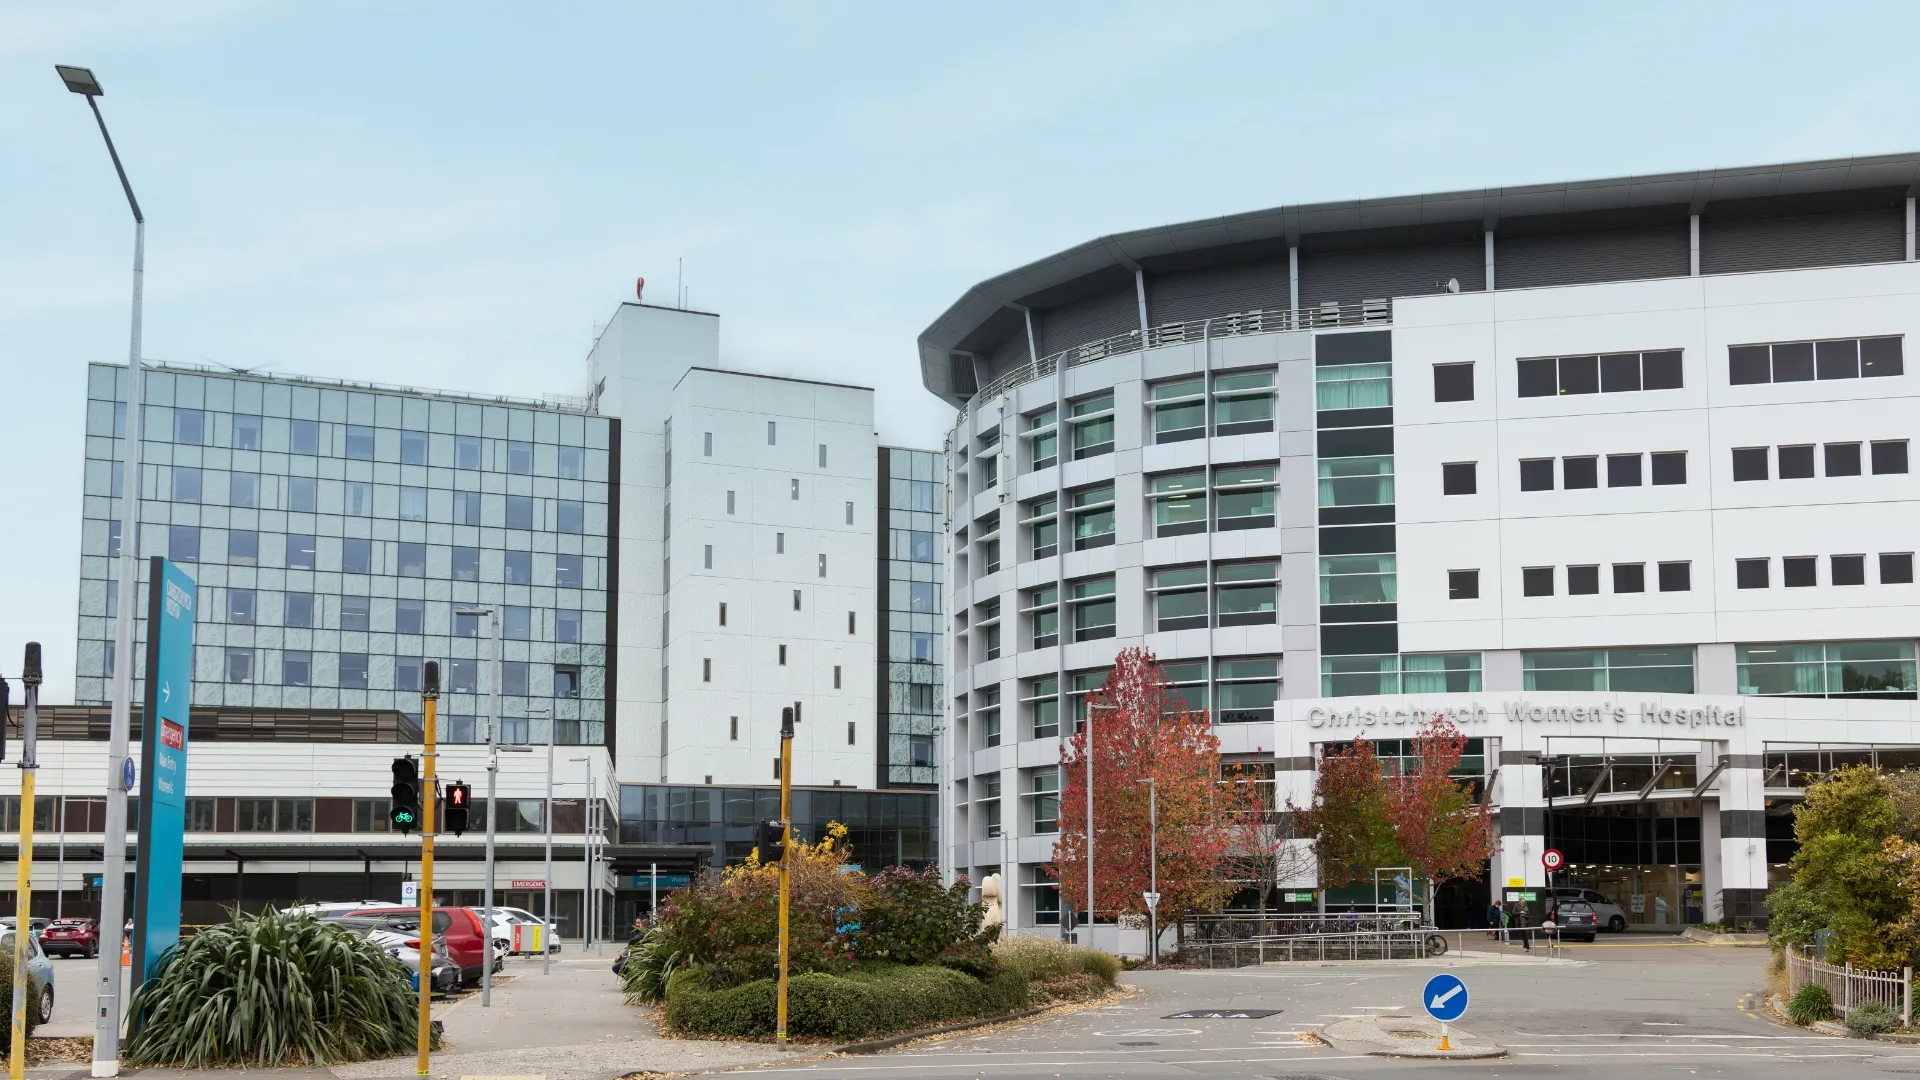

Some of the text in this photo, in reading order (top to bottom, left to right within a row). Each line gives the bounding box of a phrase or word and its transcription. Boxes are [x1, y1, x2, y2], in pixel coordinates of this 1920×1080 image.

[1503, 700, 1628, 723] Women's
[1641, 701, 1746, 729] Hospital
[160, 718, 183, 749] Emergency
[1547, 855, 1557, 863] 10
